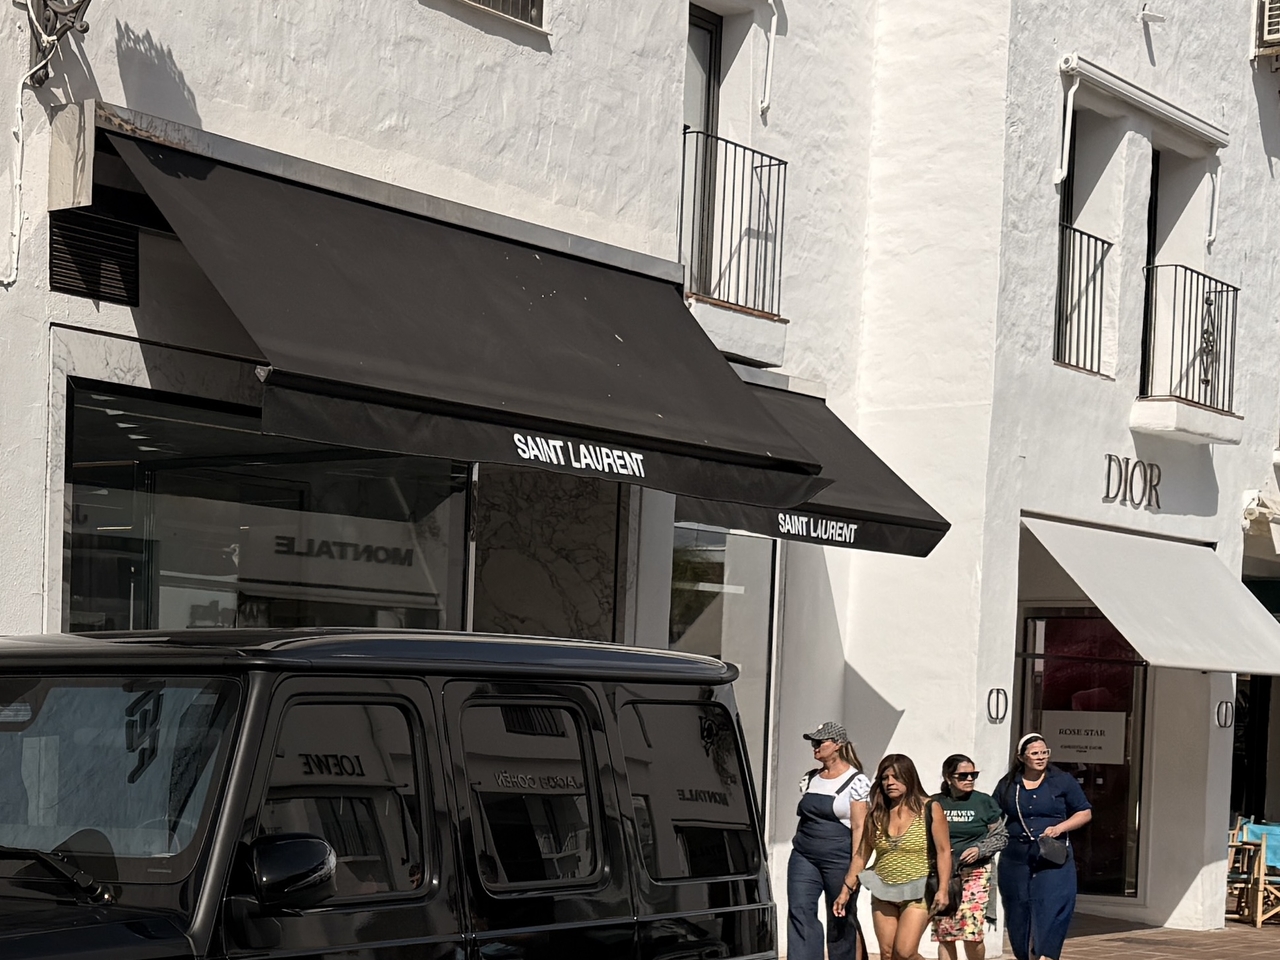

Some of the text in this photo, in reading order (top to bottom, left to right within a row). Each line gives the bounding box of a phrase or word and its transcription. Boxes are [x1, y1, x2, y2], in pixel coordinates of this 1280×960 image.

[513, 433, 645, 478] SAINT LAURENT
[1104, 453, 1161, 509] DIOR
[778, 512, 858, 543] SAINT LAURENT
[1058, 728, 1106, 737] ROSE STAR
